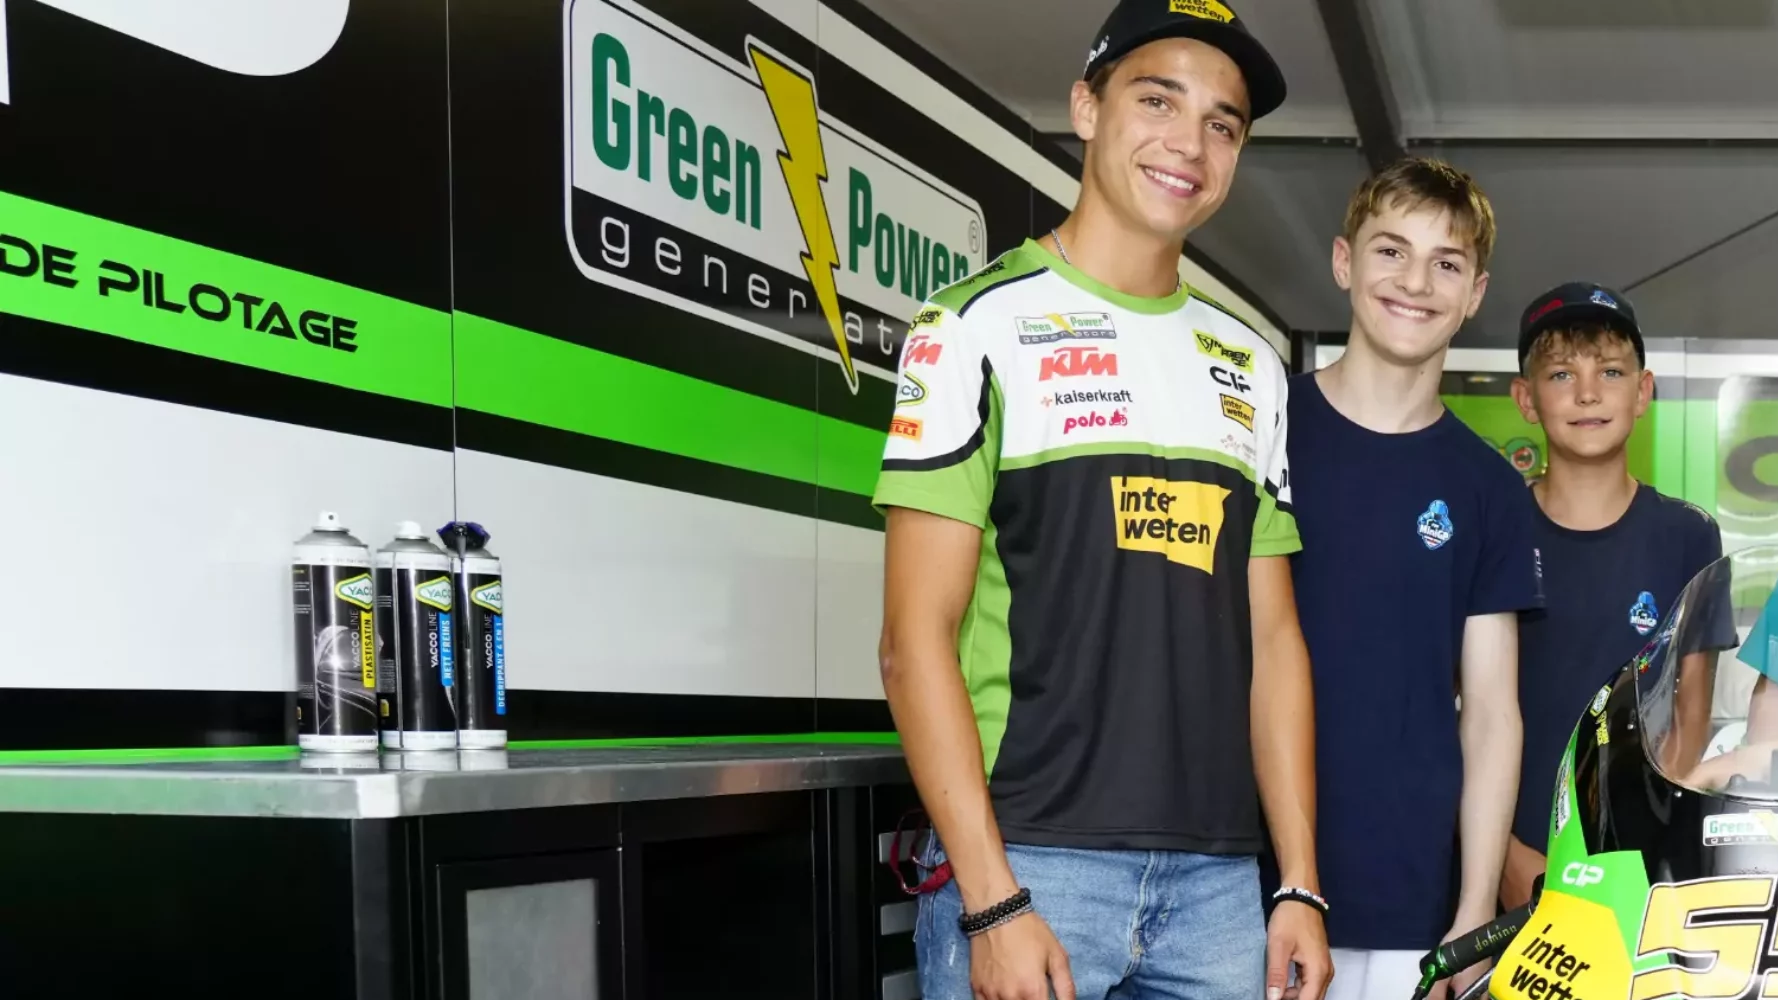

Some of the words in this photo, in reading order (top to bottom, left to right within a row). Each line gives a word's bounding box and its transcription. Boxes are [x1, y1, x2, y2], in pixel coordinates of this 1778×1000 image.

[1175, 3, 1225, 22] wetten
[590, 32, 762, 230] Green
[0, 234, 78, 285] DE
[97, 260, 360, 354] PILOTAGE
[1022, 320, 1052, 332] Green
[1069, 315, 1104, 328] Power
[1039, 346, 1118, 381] KTM
[1054, 389, 1134, 406] kaiserkraft
[1223, 395, 1243, 411] inter
[1063, 411, 1107, 434] polo
[1123, 517, 1211, 546] weten
[364, 618, 373, 680] PLASTISATIN
[441, 620, 451, 654] FREINS
[1709, 819, 1755, 835] Green
[1562, 862, 1605, 888] CIP
[1521, 924, 1591, 982] inter
